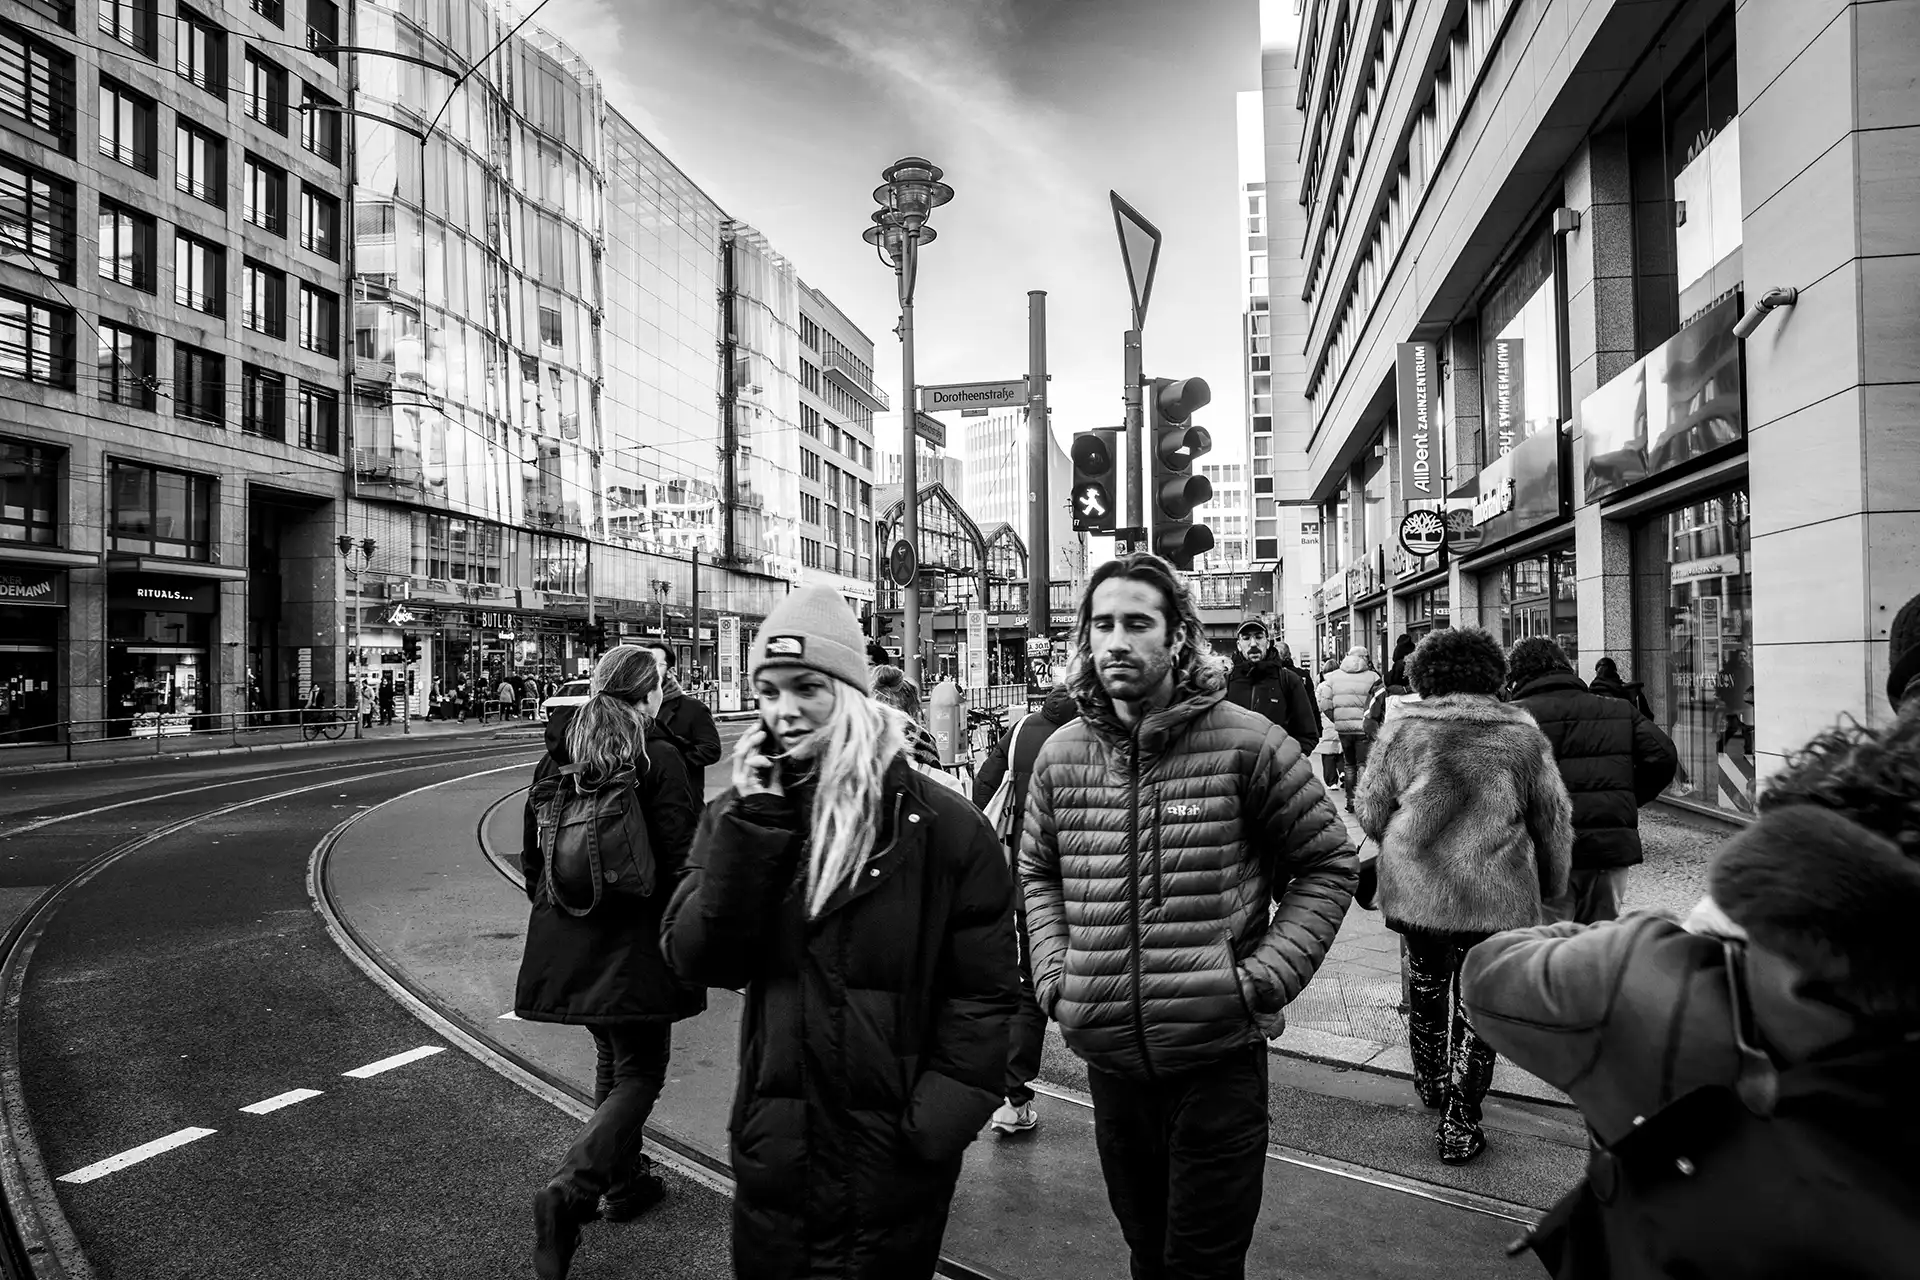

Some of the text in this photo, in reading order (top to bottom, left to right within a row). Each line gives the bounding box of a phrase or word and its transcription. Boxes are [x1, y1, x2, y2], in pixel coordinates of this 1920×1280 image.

[933, 387, 1015, 403] Dorotheenstraße
[1413, 345, 1431, 493] AllDent ZAHNZENTRUM
[1301, 537, 1319, 545] Bank
[137, 588, 194, 600] RITUALS...
[482, 612, 517, 628] BUTLERS
[1178, 804, 1200, 816] Rab
